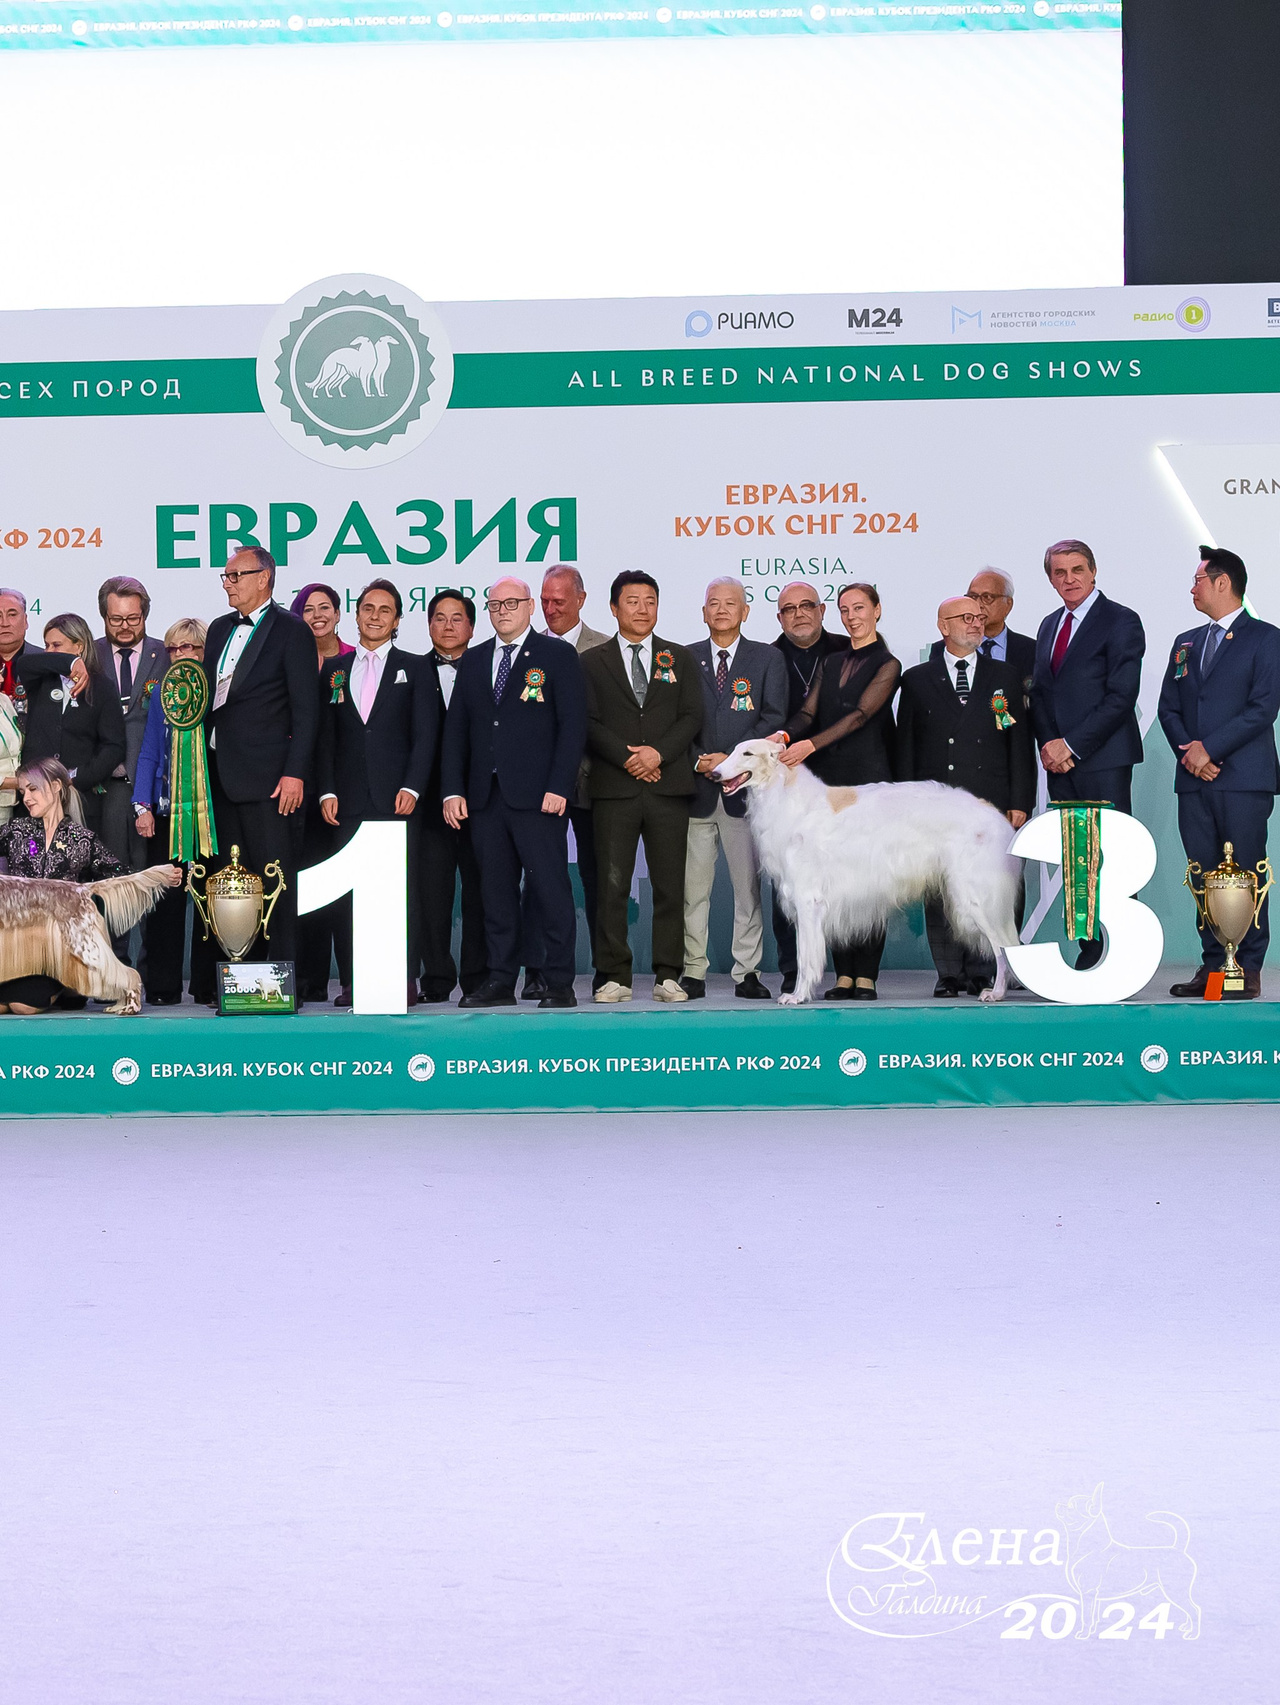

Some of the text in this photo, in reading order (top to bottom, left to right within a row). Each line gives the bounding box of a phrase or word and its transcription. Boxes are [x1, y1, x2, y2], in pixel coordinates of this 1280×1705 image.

[990, 310, 1096, 319] АГЕНТСТВО ГОРОДСКИХ
[990, 320, 1037, 328] НОВОСТЕЙ
[568, 359, 1142, 388] ALL BREED NATIONAL DOG SHOWS
[73, 378, 182, 399] ПОРОД
[726, 482, 867, 505] ЕВРАЗИЯ.
[156, 497, 577, 568] ЕВРАЗИЯ
[674, 512, 919, 537] КУБОК СНГ 2024
[37, 526, 104, 549] 2024
[741, 557, 853, 576] EURASIA.
[1004, 808, 1164, 1004] 3
[297, 821, 408, 1014] 1
[446, 1055, 821, 1075] ЕВРАЗИЯ. КУБОК ПРЕЗИДЕНТА РКФ 2024
[878, 1051, 1124, 1069] ЕВРАЗИЯ. КУБОК СНГ 2024
[1179, 1050, 1267, 1066] ЕВРАЗИЯ.
[11, 1064, 49, 1080] РКФ
[54, 1064, 95, 1079] 2024
[151, 1060, 393, 1078] ЕВРАЗИЯ. КУБОК СНГ 2024
